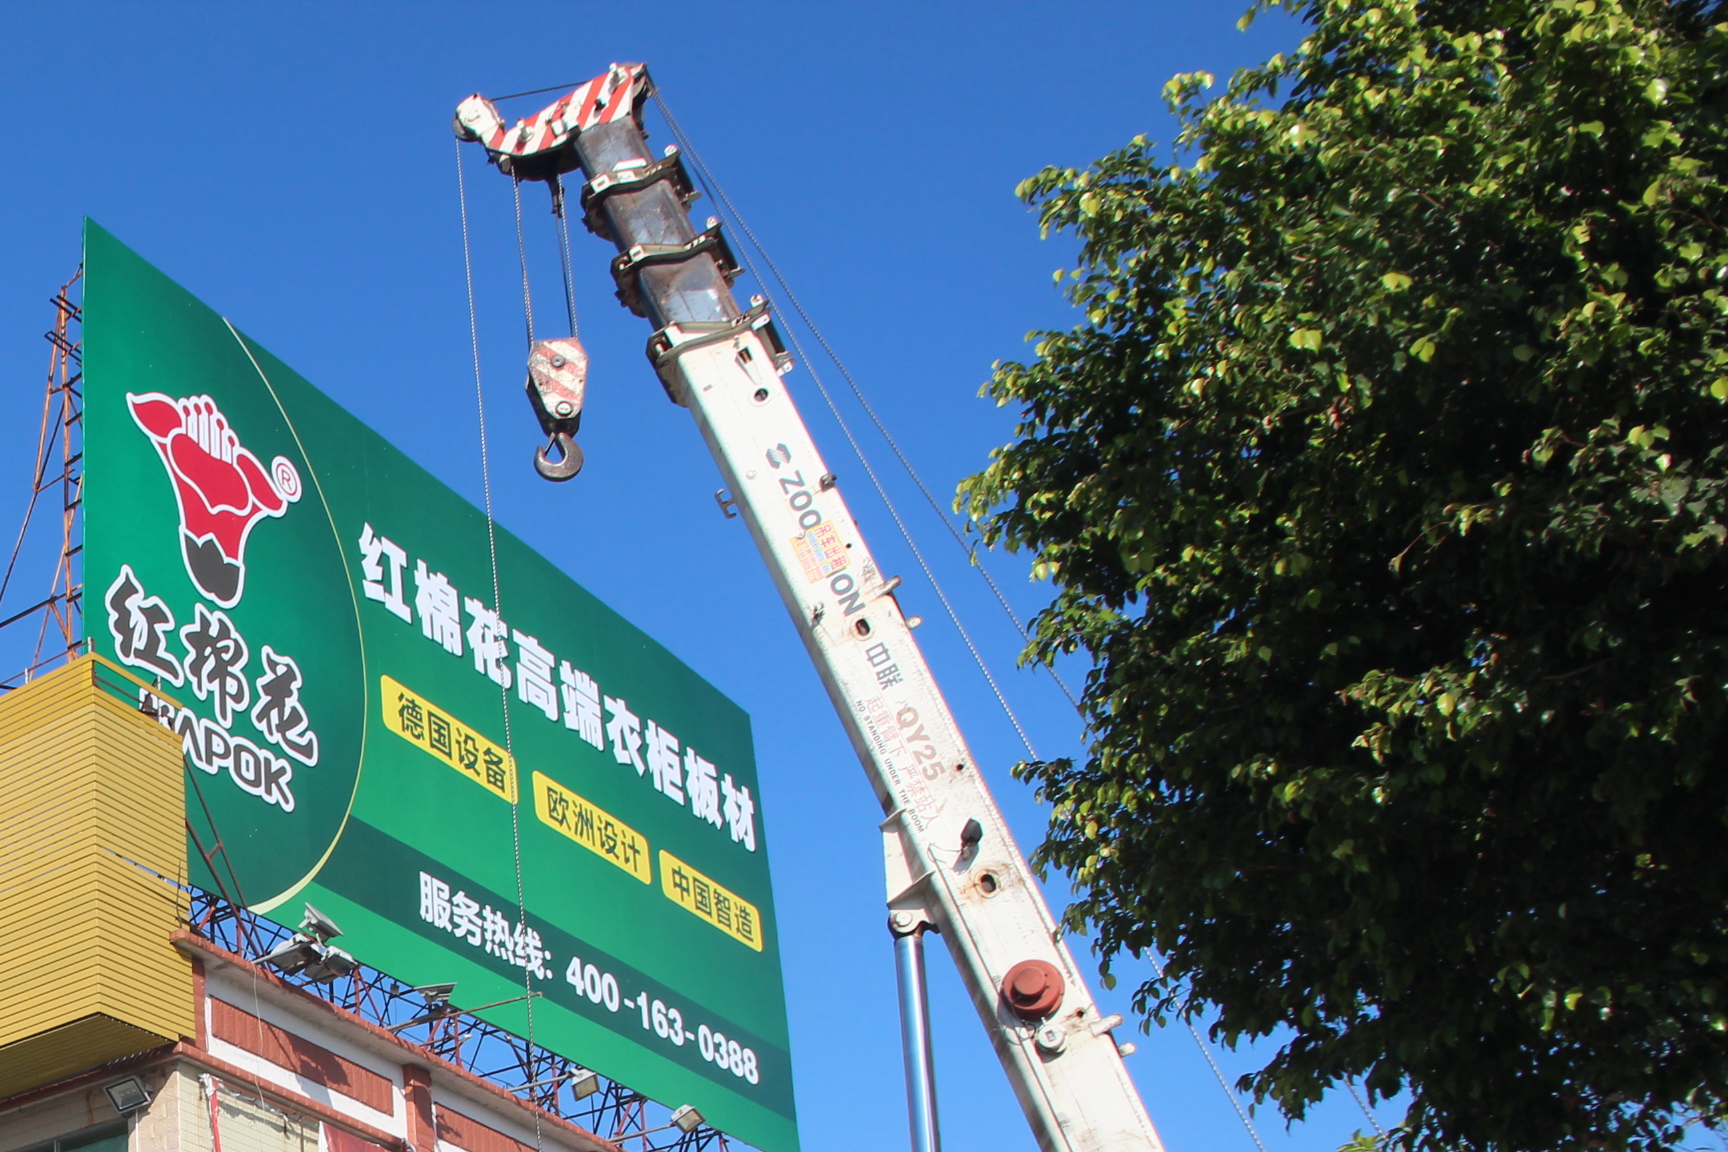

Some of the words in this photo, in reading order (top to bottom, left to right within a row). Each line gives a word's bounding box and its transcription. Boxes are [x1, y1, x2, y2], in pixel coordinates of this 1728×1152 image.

[105, 564, 319, 768] 红棉花
[357, 521, 757, 853] 红棉花高端衣柜板材
[865, 641, 904, 691] 中联
[397, 691, 507, 794] 德国设备
[863, 715, 887, 756] STANDING
[883, 757, 901, 786] UNDER
[898, 788, 911, 807] THE
[545, 784, 641, 874] 欧洲设计
[671, 865, 755, 943] 中国智造
[565, 955, 760, 1086] 400-163-0388
